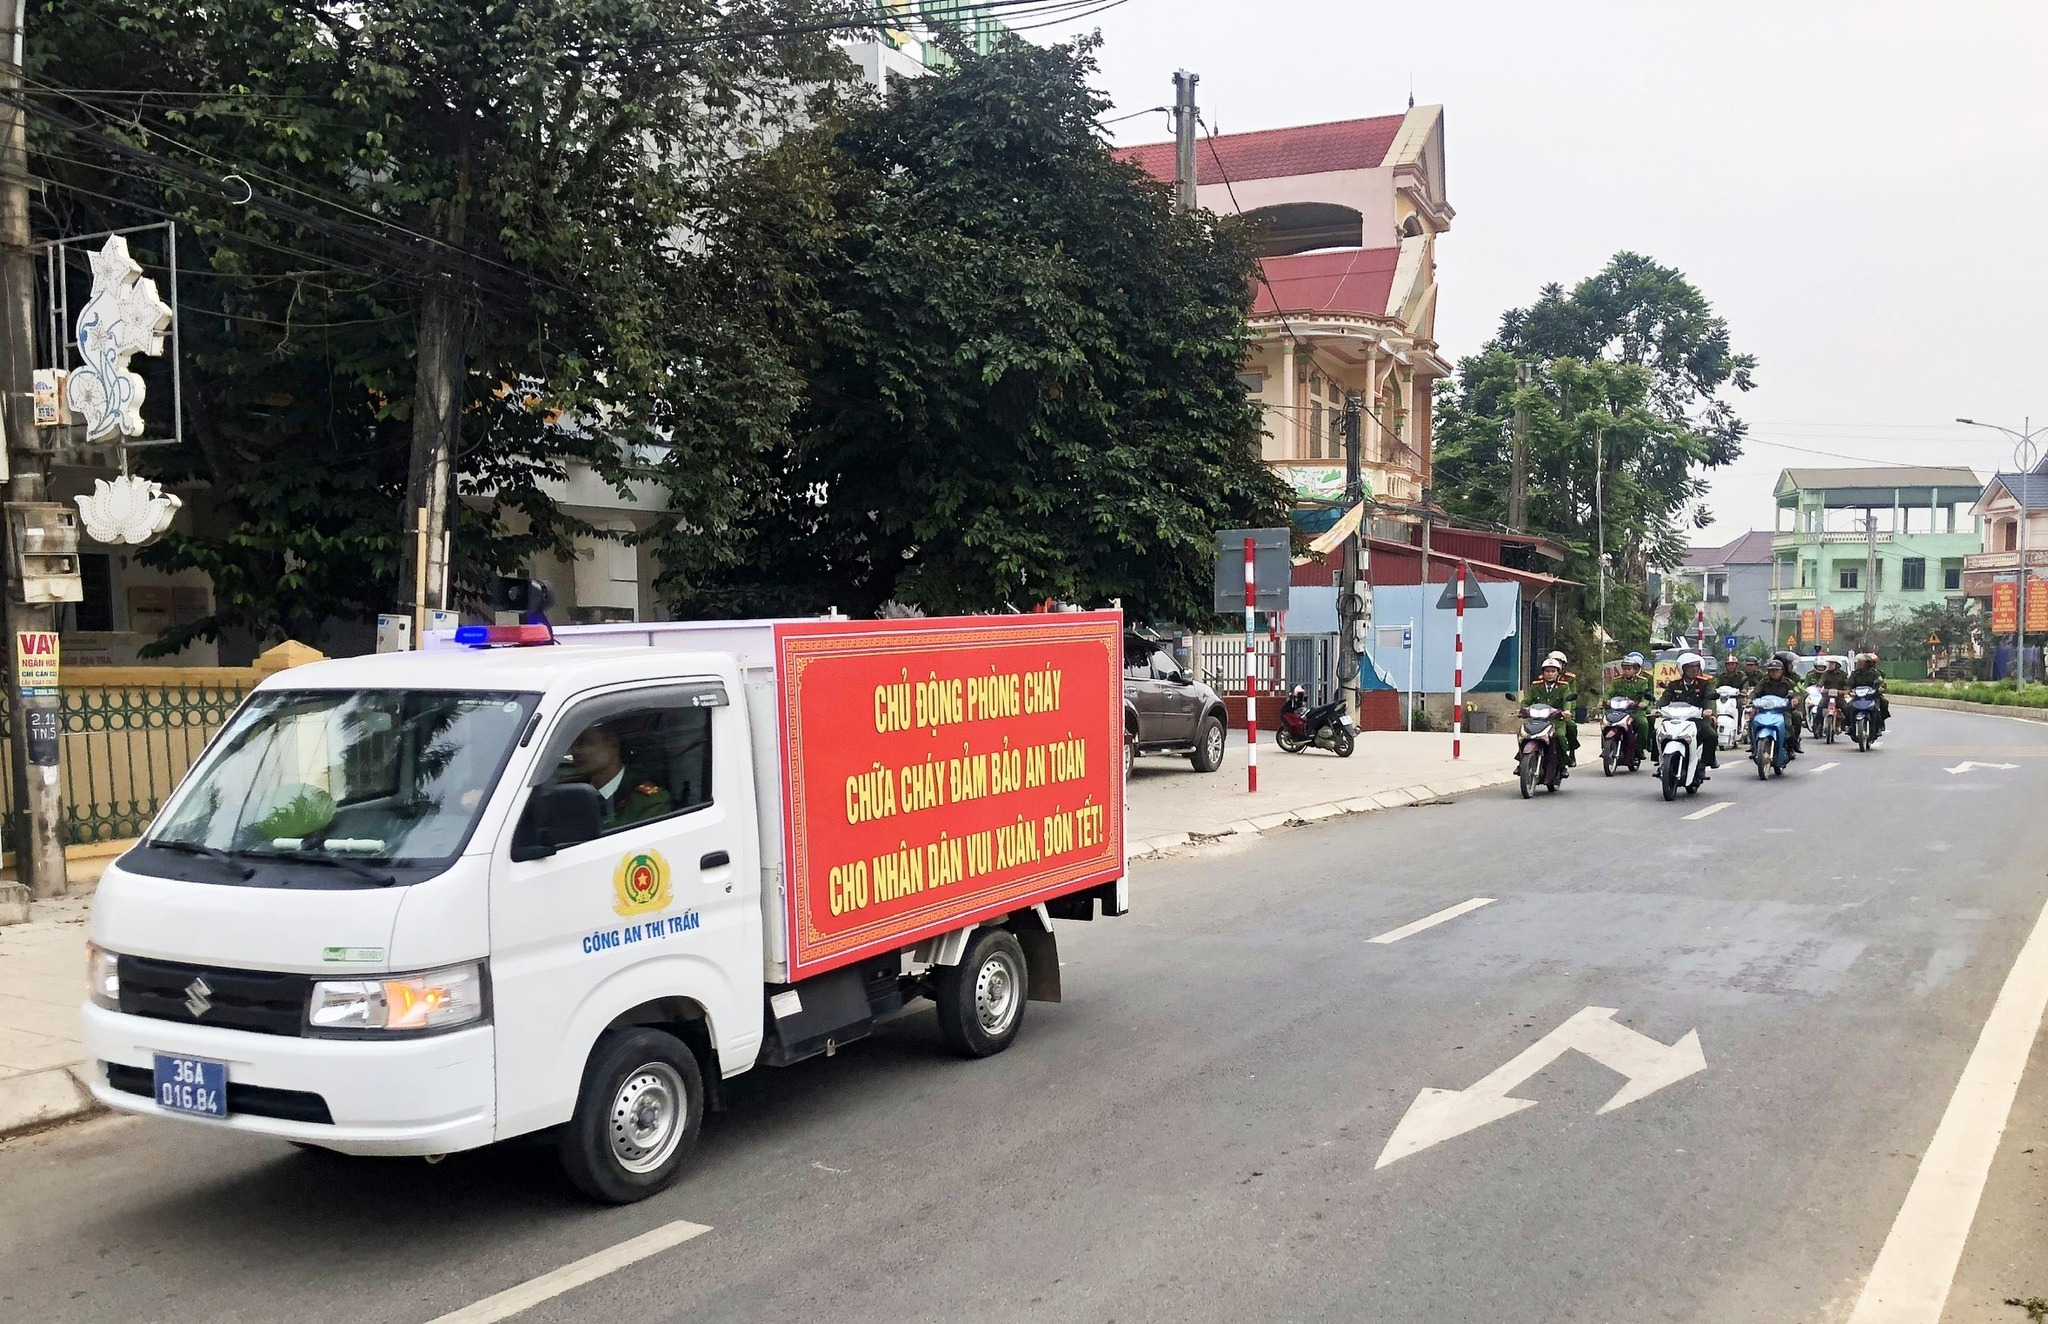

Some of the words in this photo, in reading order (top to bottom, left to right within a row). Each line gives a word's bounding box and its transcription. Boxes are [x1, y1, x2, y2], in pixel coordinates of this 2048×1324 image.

[20, 634, 57, 655] VAY
[31, 713, 56, 726] 2.11
[873, 667, 911, 734] CHỦ
[915, 670, 963, 738] ĐỘNG
[967, 665, 1021, 722] PHÒNG
[1023, 662, 1062, 714] CHÁY
[845, 761, 897, 826] CHỮA
[900, 753, 945, 814] CHÁY
[949, 741, 987, 804] ĐẢM
[990, 735, 1022, 796] BẢO
[1025, 745, 1046, 790] AN
[1048, 731, 1086, 783] TOÀN
[828, 858, 869, 917] CHO
[872, 841, 924, 904] NHÂN
[928, 831, 963, 889] DÂN
[966, 830, 993, 876] VUI
[996, 814, 1041, 868] XUÂN,
[1043, 805, 1073, 858] ĐÓN
[1075, 794, 1104, 850] TẾT!
[583, 932, 620, 954] CÔNG
[624, 925, 642, 945] AN
[645, 920, 666, 939] THỊ
[668, 908, 700, 934] TRẤN
[172, 1059, 204, 1086] 36A
[162, 1081, 218, 1113] 016.84
